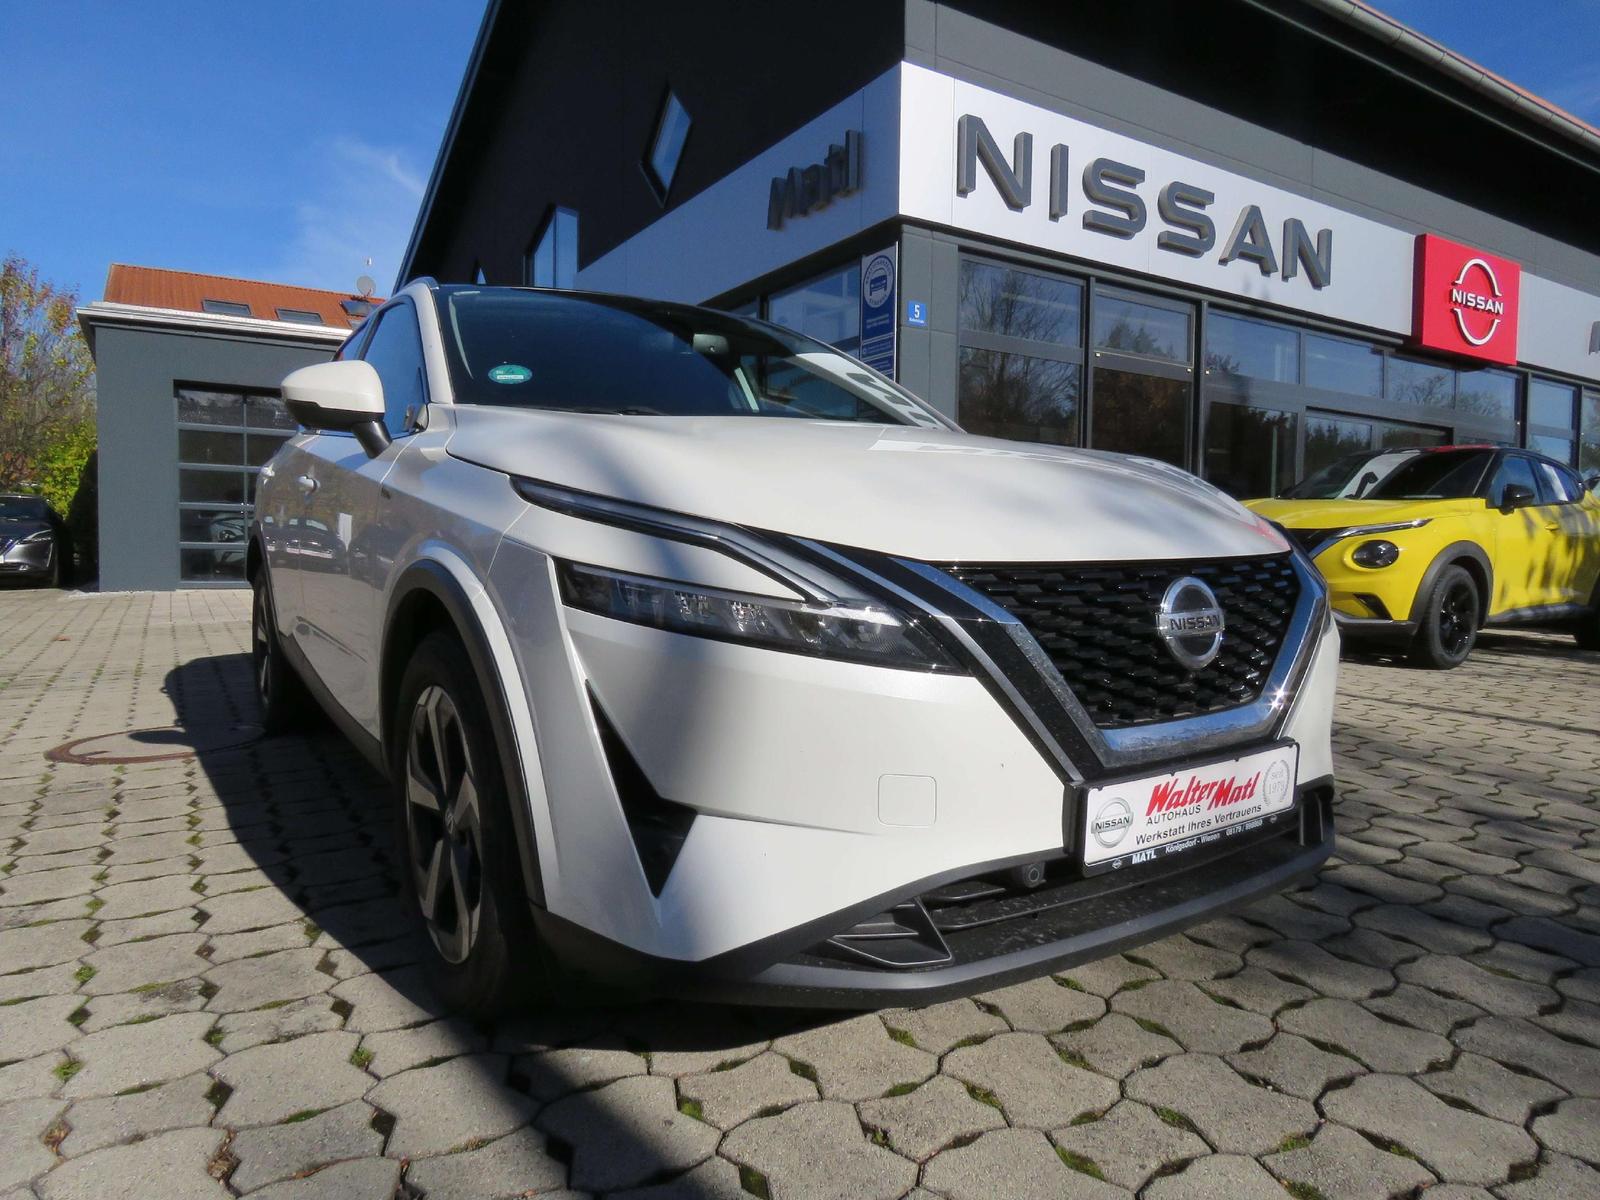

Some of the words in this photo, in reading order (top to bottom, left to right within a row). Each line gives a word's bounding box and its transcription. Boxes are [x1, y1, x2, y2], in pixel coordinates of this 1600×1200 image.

[957, 114, 1333, 290] NISSAN
[914, 304, 920, 318] 5
[1452, 288, 1504, 315] NISSAN
[1170, 614, 1220, 631] NISSAN
[1095, 816, 1130, 830] NISSAN
[1146, 804, 1201, 826] AUTOHAUS
[1135, 825, 1185, 846] Werkstatt
[1187, 818, 1212, 832] Ihres
[1214, 804, 1262, 824] Vertrauens
[1131, 849, 1157, 865] MATL
